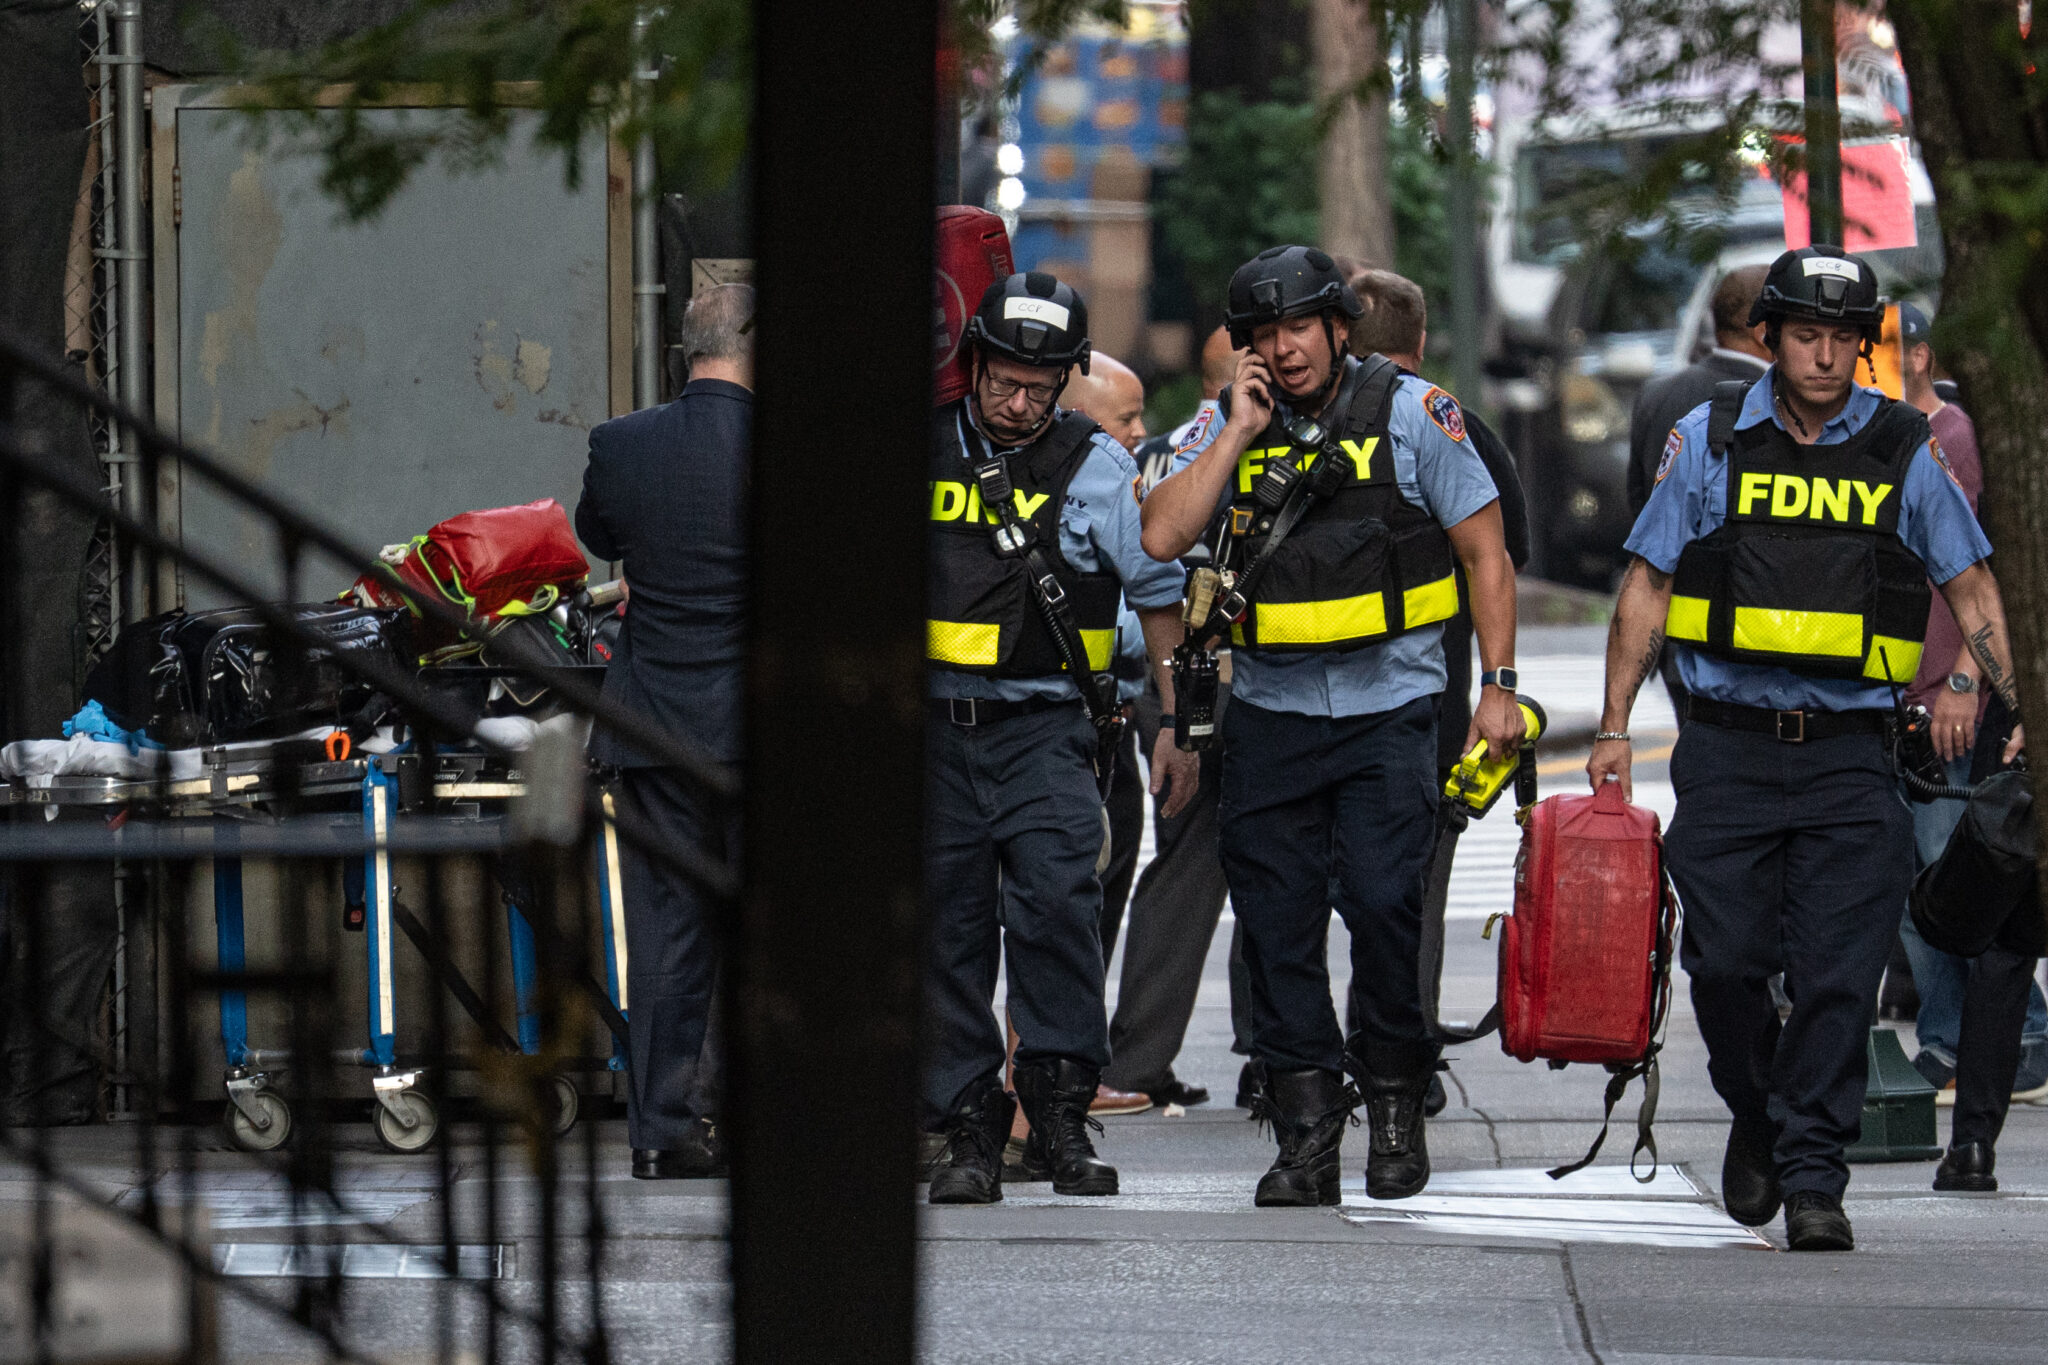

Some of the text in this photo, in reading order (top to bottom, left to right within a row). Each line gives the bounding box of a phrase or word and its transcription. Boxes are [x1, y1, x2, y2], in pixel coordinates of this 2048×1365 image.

[1238, 437, 1380, 493] FY
[929, 480, 1050, 525] DNY
[1738, 472, 1894, 525] FDNY
